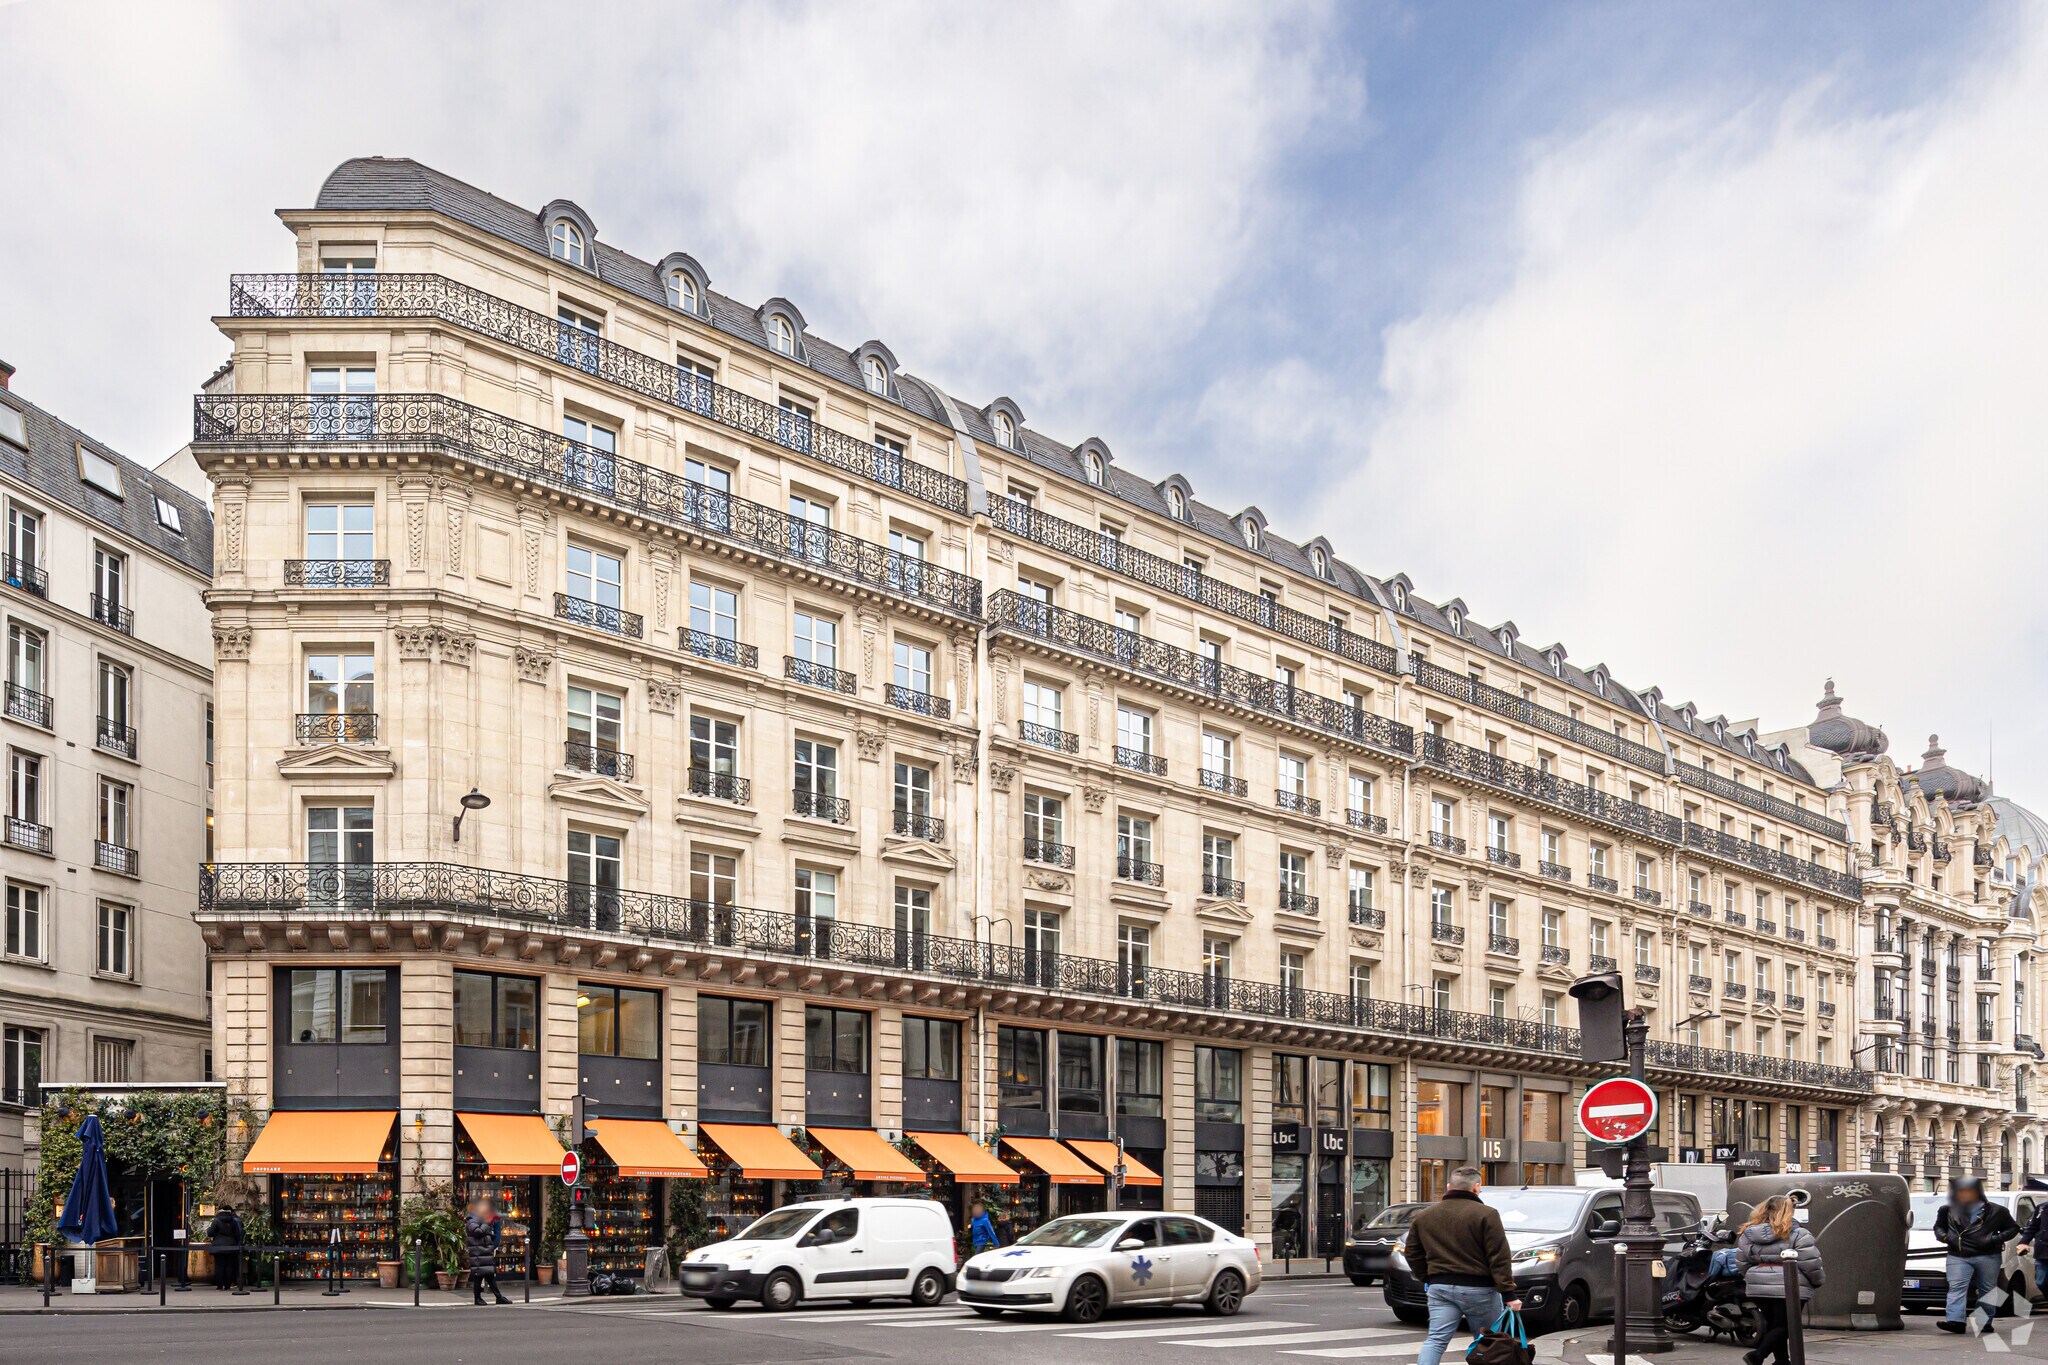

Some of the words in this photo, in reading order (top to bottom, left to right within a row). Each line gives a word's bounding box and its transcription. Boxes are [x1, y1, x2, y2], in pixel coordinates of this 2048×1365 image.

[1273, 1132, 1296, 1144] lbc
[1323, 1133, 1344, 1150] lbc
[1483, 1140, 1501, 1159] 115
